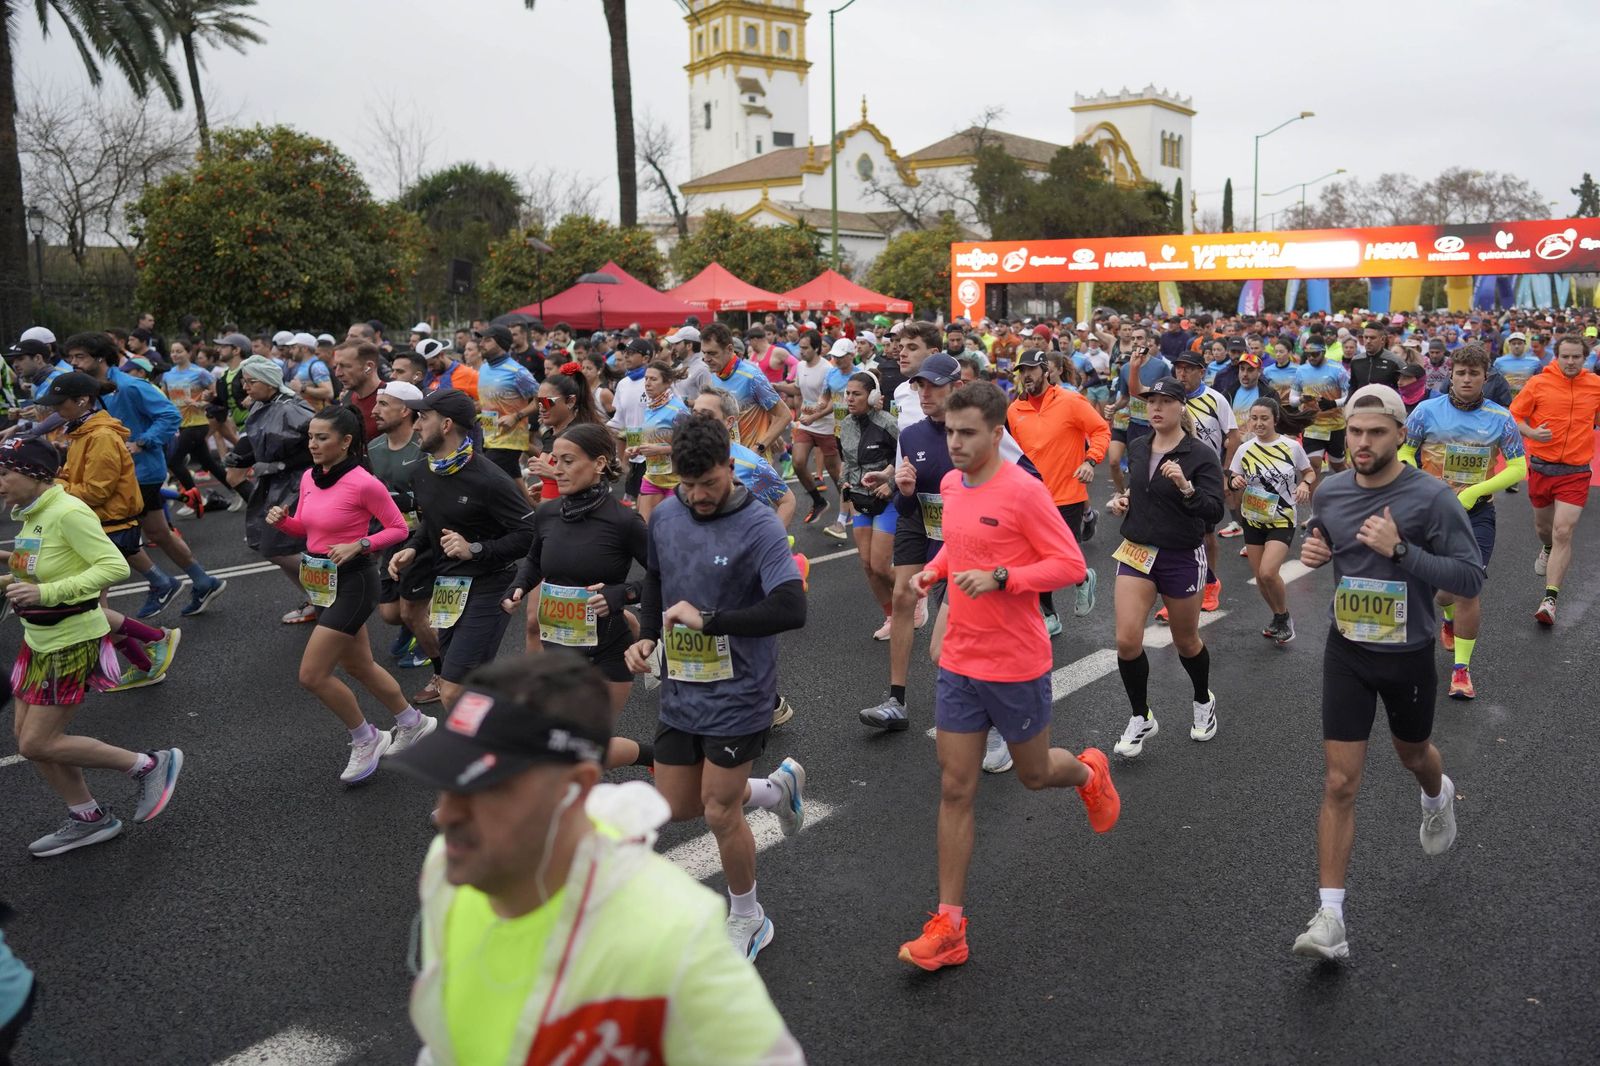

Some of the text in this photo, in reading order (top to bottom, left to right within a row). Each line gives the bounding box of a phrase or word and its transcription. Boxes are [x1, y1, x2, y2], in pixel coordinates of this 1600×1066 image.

[1104, 251, 1147, 267] HOKA
[1364, 241, 1419, 260] HOKA
[1428, 252, 1470, 261] HYUNDAI
[1449, 454, 1483, 467] 11393
[435, 589, 463, 605] 12067
[1340, 592, 1395, 615] 10107
[543, 598, 586, 620] 12905
[668, 631, 714, 652] 12907
